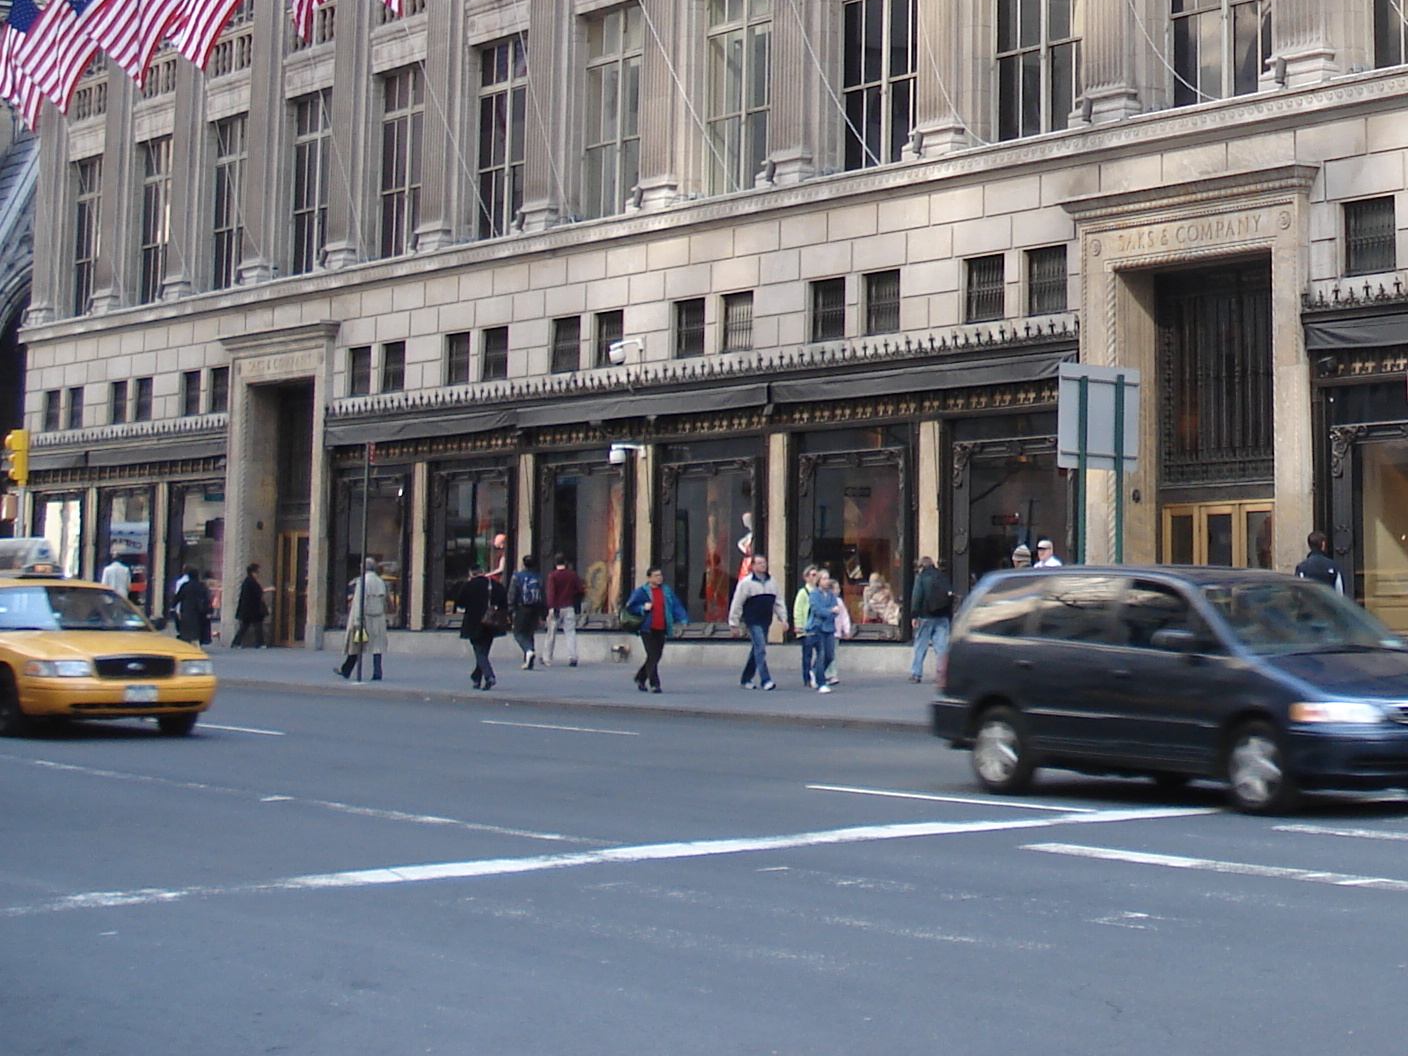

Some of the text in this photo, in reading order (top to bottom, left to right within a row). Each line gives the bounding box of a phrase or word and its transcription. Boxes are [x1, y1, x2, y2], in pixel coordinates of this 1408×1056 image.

[1118, 214, 1262, 252] SAKS & COMPANY
